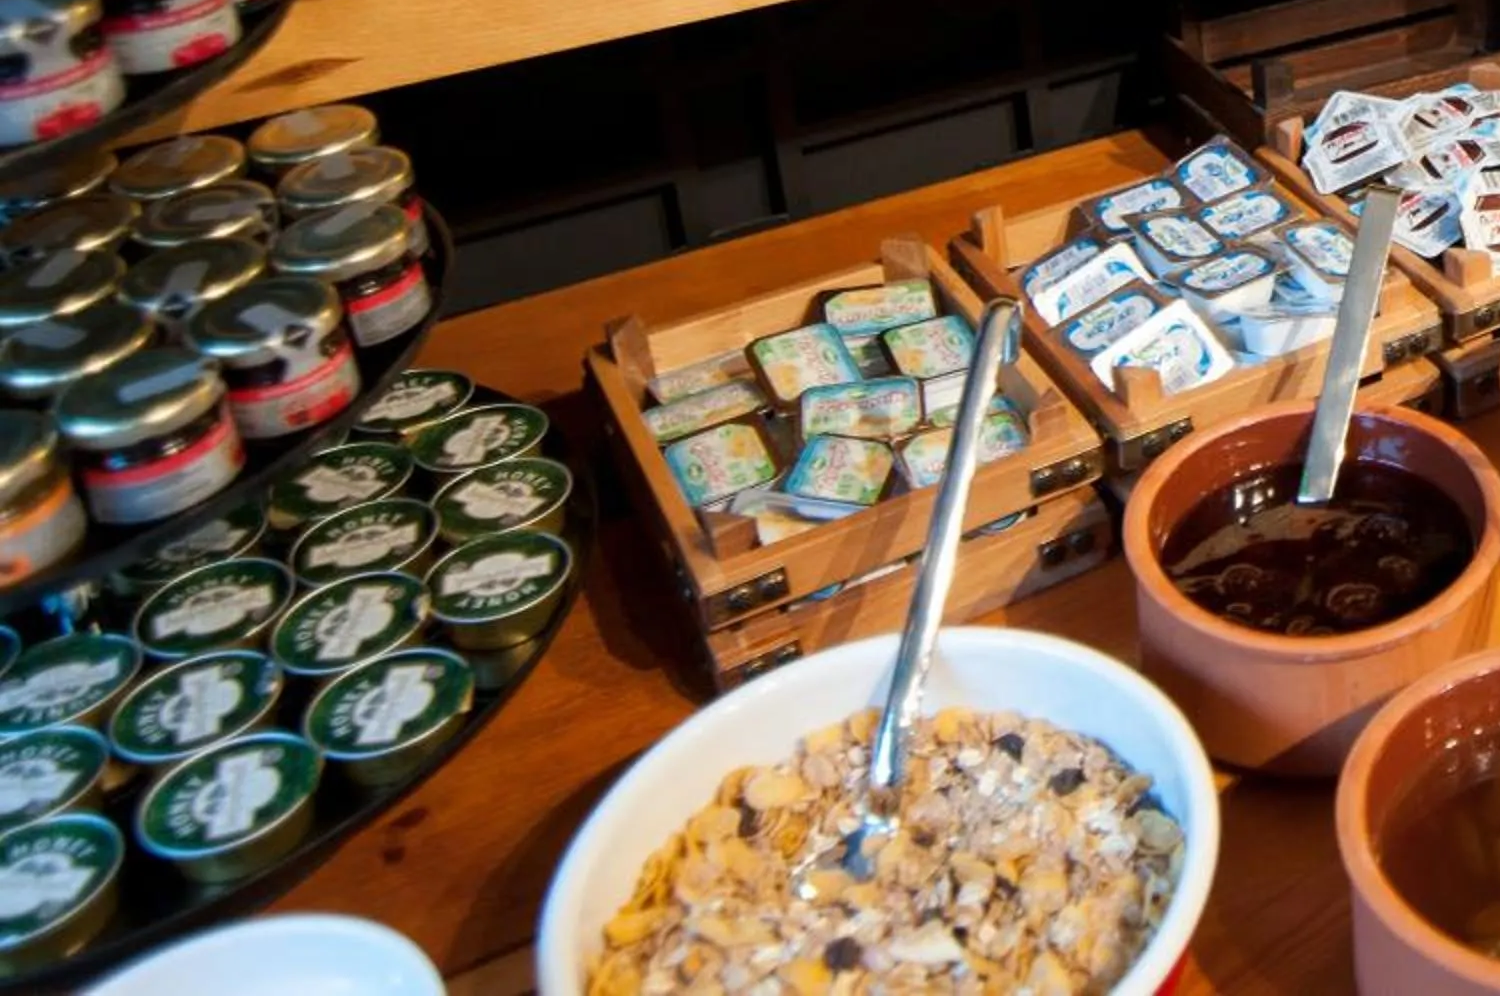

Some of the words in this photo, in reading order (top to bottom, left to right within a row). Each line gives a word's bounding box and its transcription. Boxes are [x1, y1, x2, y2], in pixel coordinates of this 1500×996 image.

[494, 470, 553, 491] HONEY
[326, 513, 404, 538] HONEY
[454, 583, 538, 609] HONEY
[11, 836, 97, 858] HONEY
